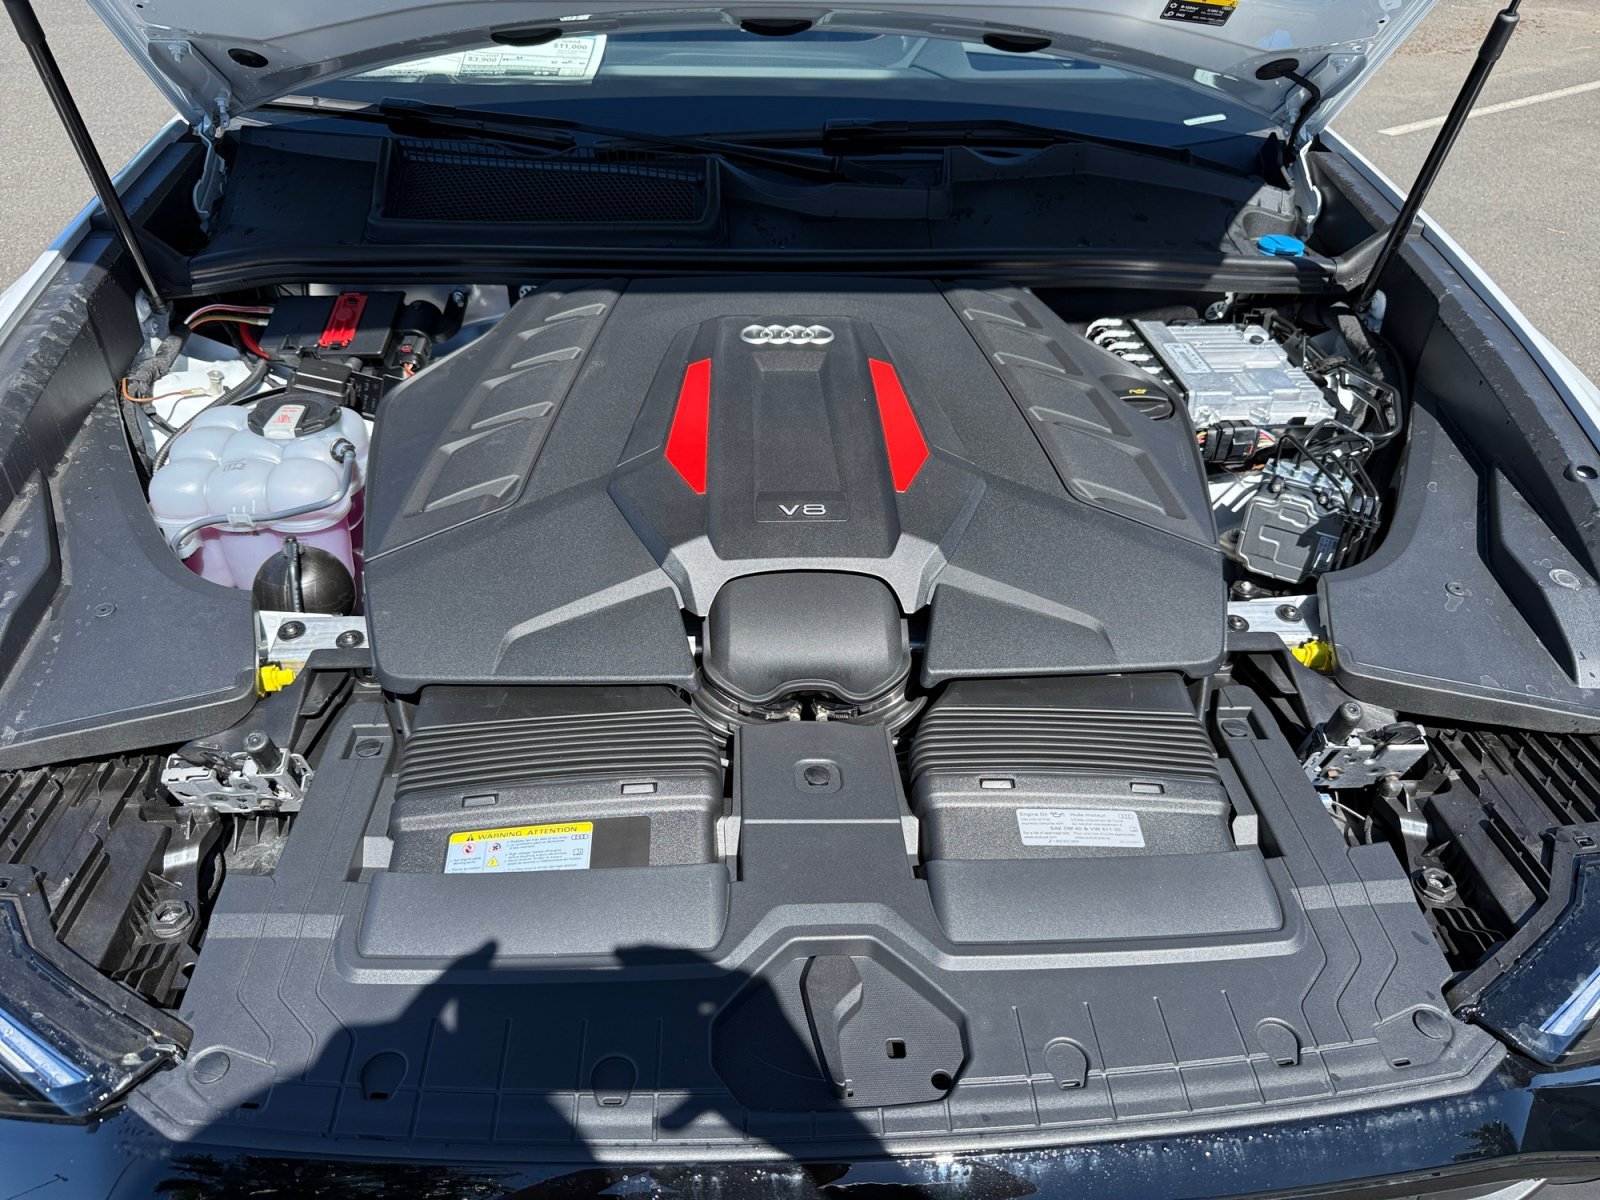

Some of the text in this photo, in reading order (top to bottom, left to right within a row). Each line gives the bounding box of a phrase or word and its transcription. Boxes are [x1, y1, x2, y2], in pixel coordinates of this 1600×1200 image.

[778, 504, 827, 516] V8
[478, 827, 578, 840] WARNING ATTENTION
